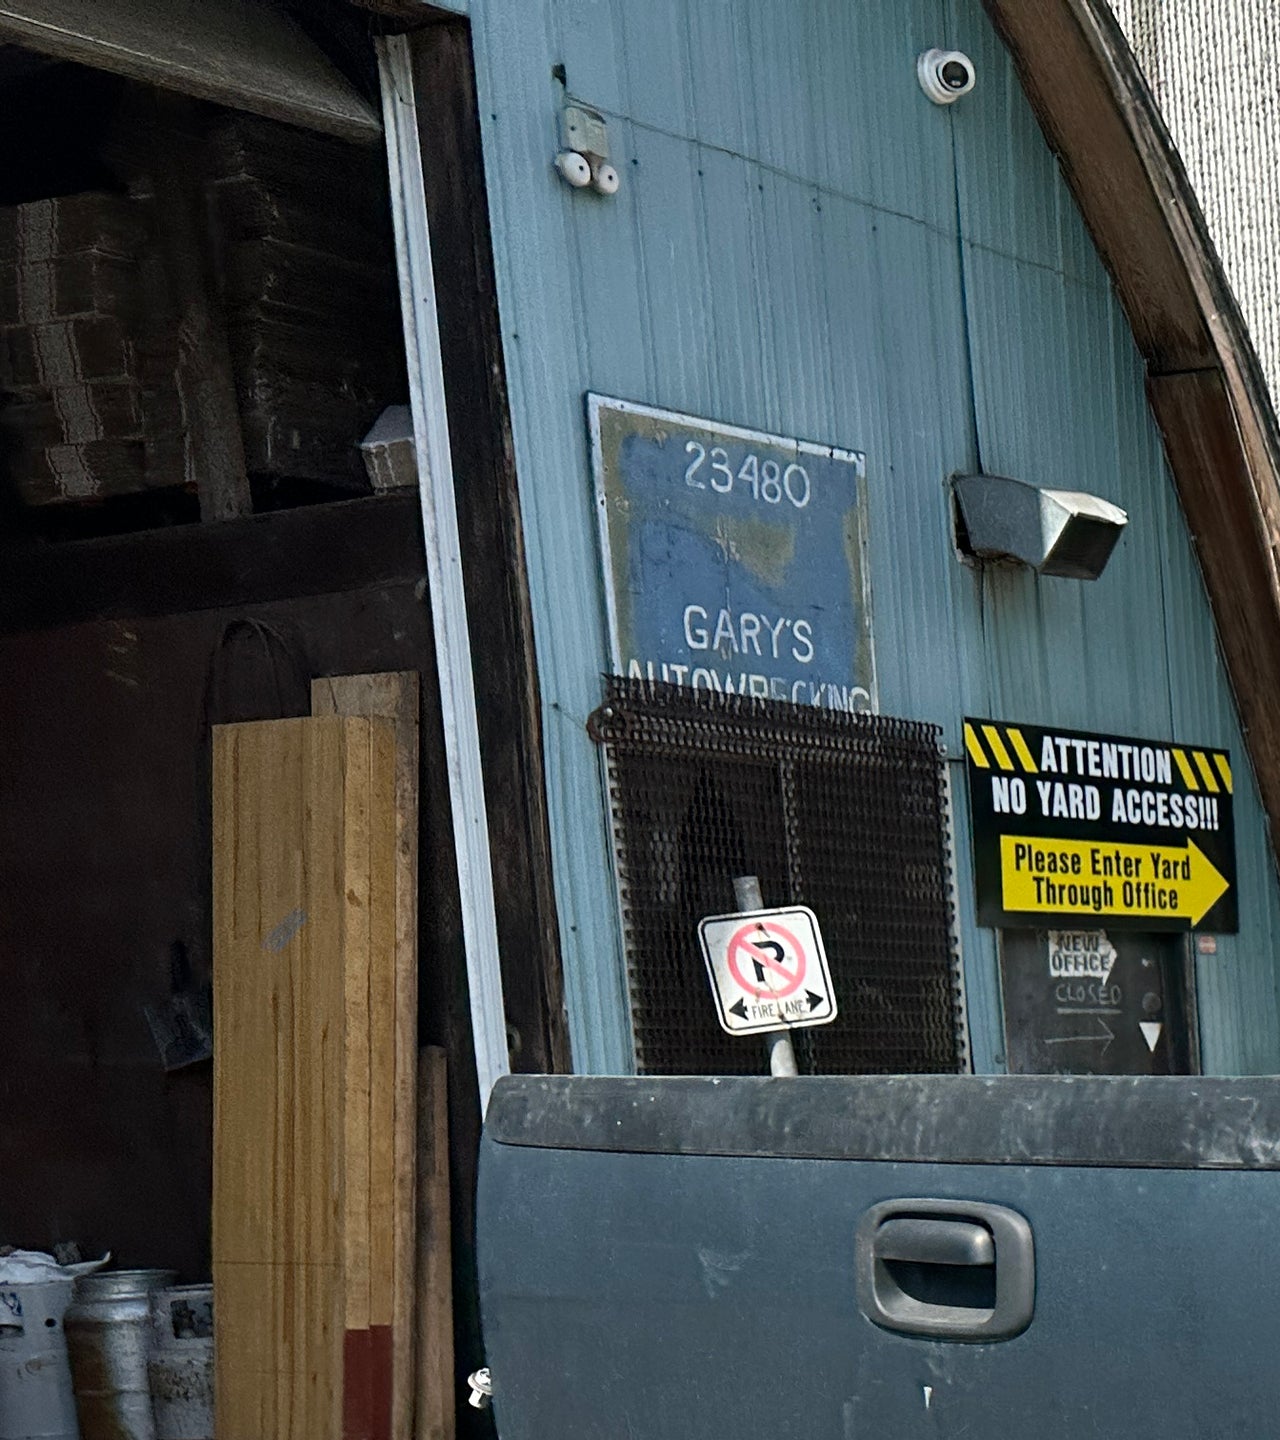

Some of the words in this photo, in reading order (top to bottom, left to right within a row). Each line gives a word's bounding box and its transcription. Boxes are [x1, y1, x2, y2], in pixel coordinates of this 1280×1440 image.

[685, 441, 811, 508] 23480
[684, 605, 814, 663] GARY'S
[1040, 735, 1173, 785] ATTENTION
[991, 776, 1027, 815] NO
[1036, 780, 1101, 821] YARD
[1112, 788, 1219, 830] ACCESS!!!
[1014, 843, 1081, 875] Please
[1091, 848, 1142, 878] Enter
[1150, 852, 1191, 881] Yard
[1032, 876, 1114, 911] Through
[1122, 881, 1178, 910] Office
[1059, 934, 1099, 951] NEW
[1052, 952, 1110, 972] OFFICE
[752, 1003, 776, 1019] FIRE
[1055, 983, 1122, 1005] CLOSED
